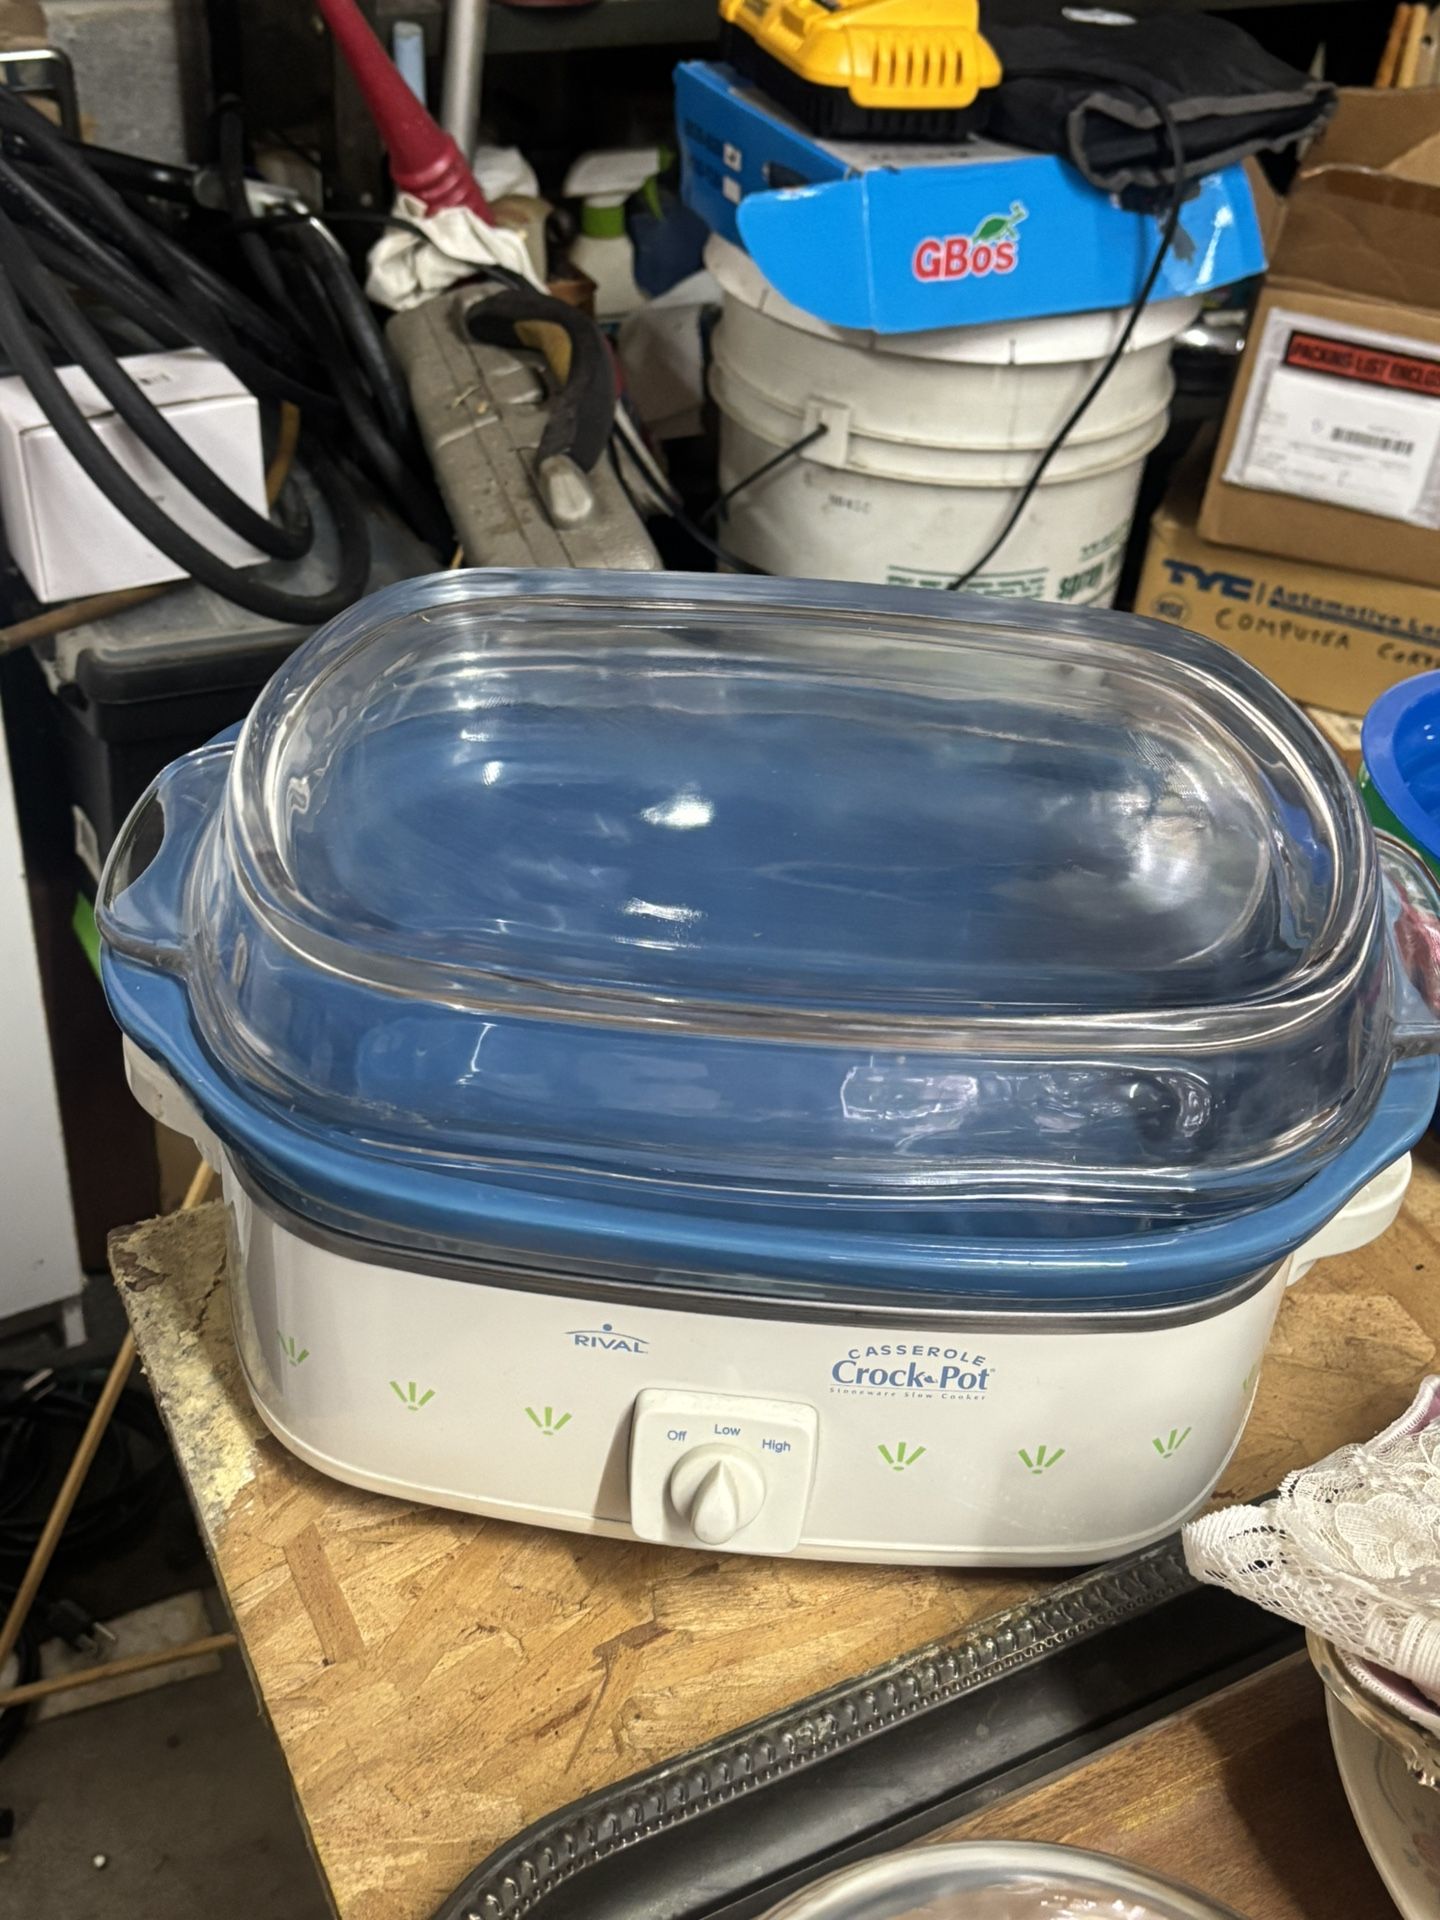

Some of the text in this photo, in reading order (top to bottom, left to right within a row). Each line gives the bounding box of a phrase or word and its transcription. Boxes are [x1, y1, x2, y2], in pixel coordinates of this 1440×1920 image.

[1355, 356, 1389, 376] LIST
[1163, 559, 1254, 601] TYC
[1270, 586, 1401, 630] Automotive
[574, 1334, 649, 1354] RIVAL
[848, 1345, 986, 1367] CASSEROLE
[829, 1387, 896, 1397] Stoneware
[667, 1424, 791, 1453] Off Low High
